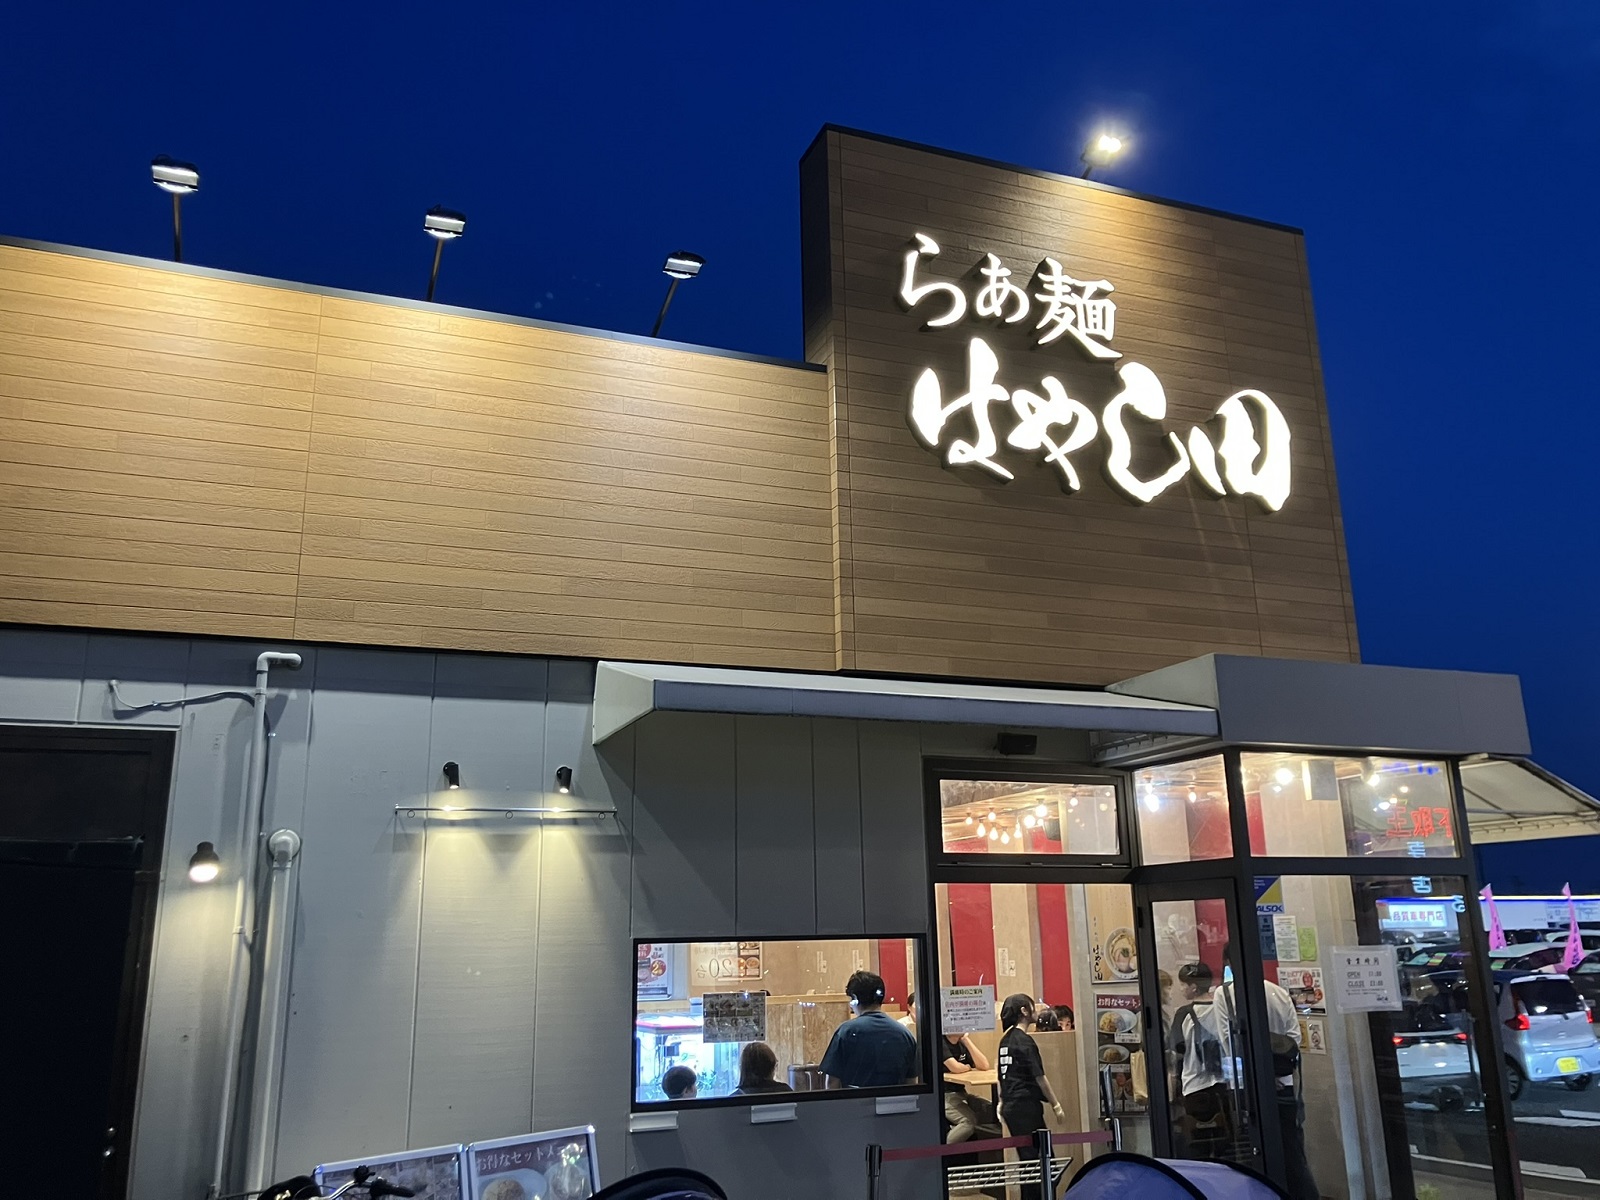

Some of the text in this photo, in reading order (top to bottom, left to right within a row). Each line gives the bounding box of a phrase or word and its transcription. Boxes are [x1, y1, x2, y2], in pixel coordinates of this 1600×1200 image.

[911, 337, 1292, 511] はやし田
[1257, 905, 1283, 913] ALSOK
[1390, 910, 1444, 922] 品質車専門店
[1348, 980, 1365, 988] CLOSE
[476, 1143, 586, 1171] お得なセットメニ
